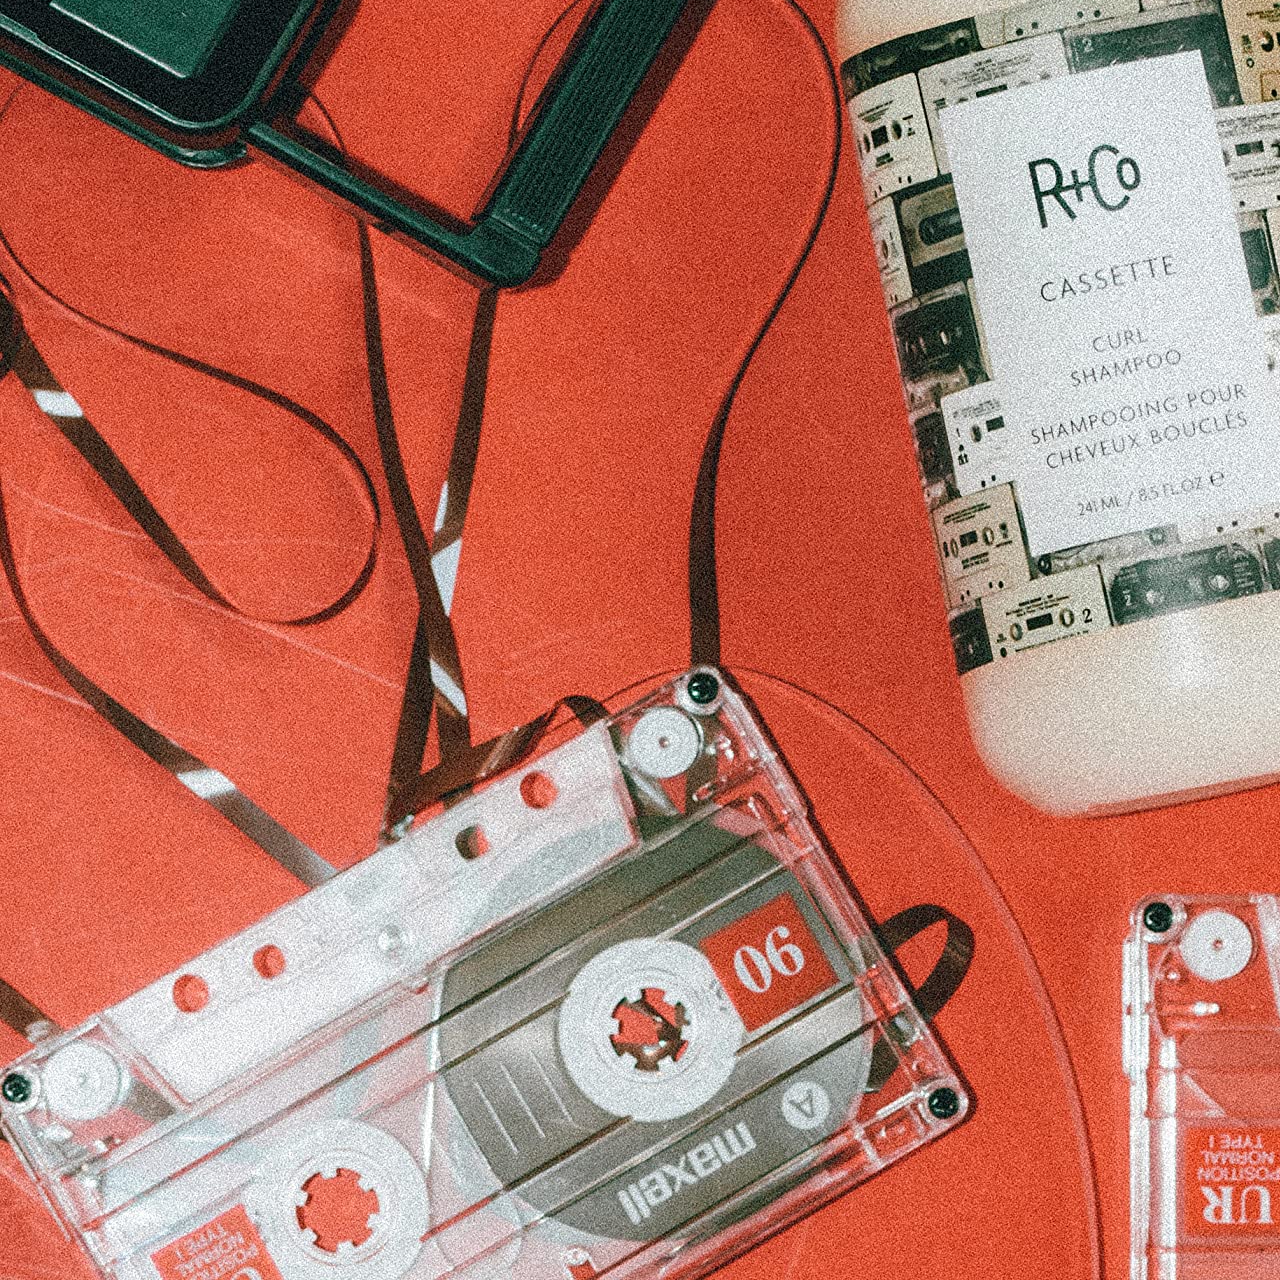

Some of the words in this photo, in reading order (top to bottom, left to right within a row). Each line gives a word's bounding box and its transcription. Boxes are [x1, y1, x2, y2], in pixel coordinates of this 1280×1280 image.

[1028, 144, 1141, 229] R+Co
[1040, 255, 1177, 302] CASSETTE
[1092, 328, 1149, 352] CURL
[1070, 349, 1182, 387] SHAMPOO
[1031, 397, 1178, 445] SHAMPOOING
[1187, 383, 1247, 408] POUR
[1046, 434, 1140, 469] CHEVEUX
[1150, 408, 1248, 445] BOUCLÉS
[733, 926, 805, 994] 90
[788, 1088, 818, 1120] A
[1200, 1150, 1276, 1165] NORMAL
[1219, 1133, 1264, 1149] TYPE
[617, 1122, 757, 1225] maxell
[1197, 1166, 1280, 1182] POSITION
[1200, 1185, 1275, 1224] UR
